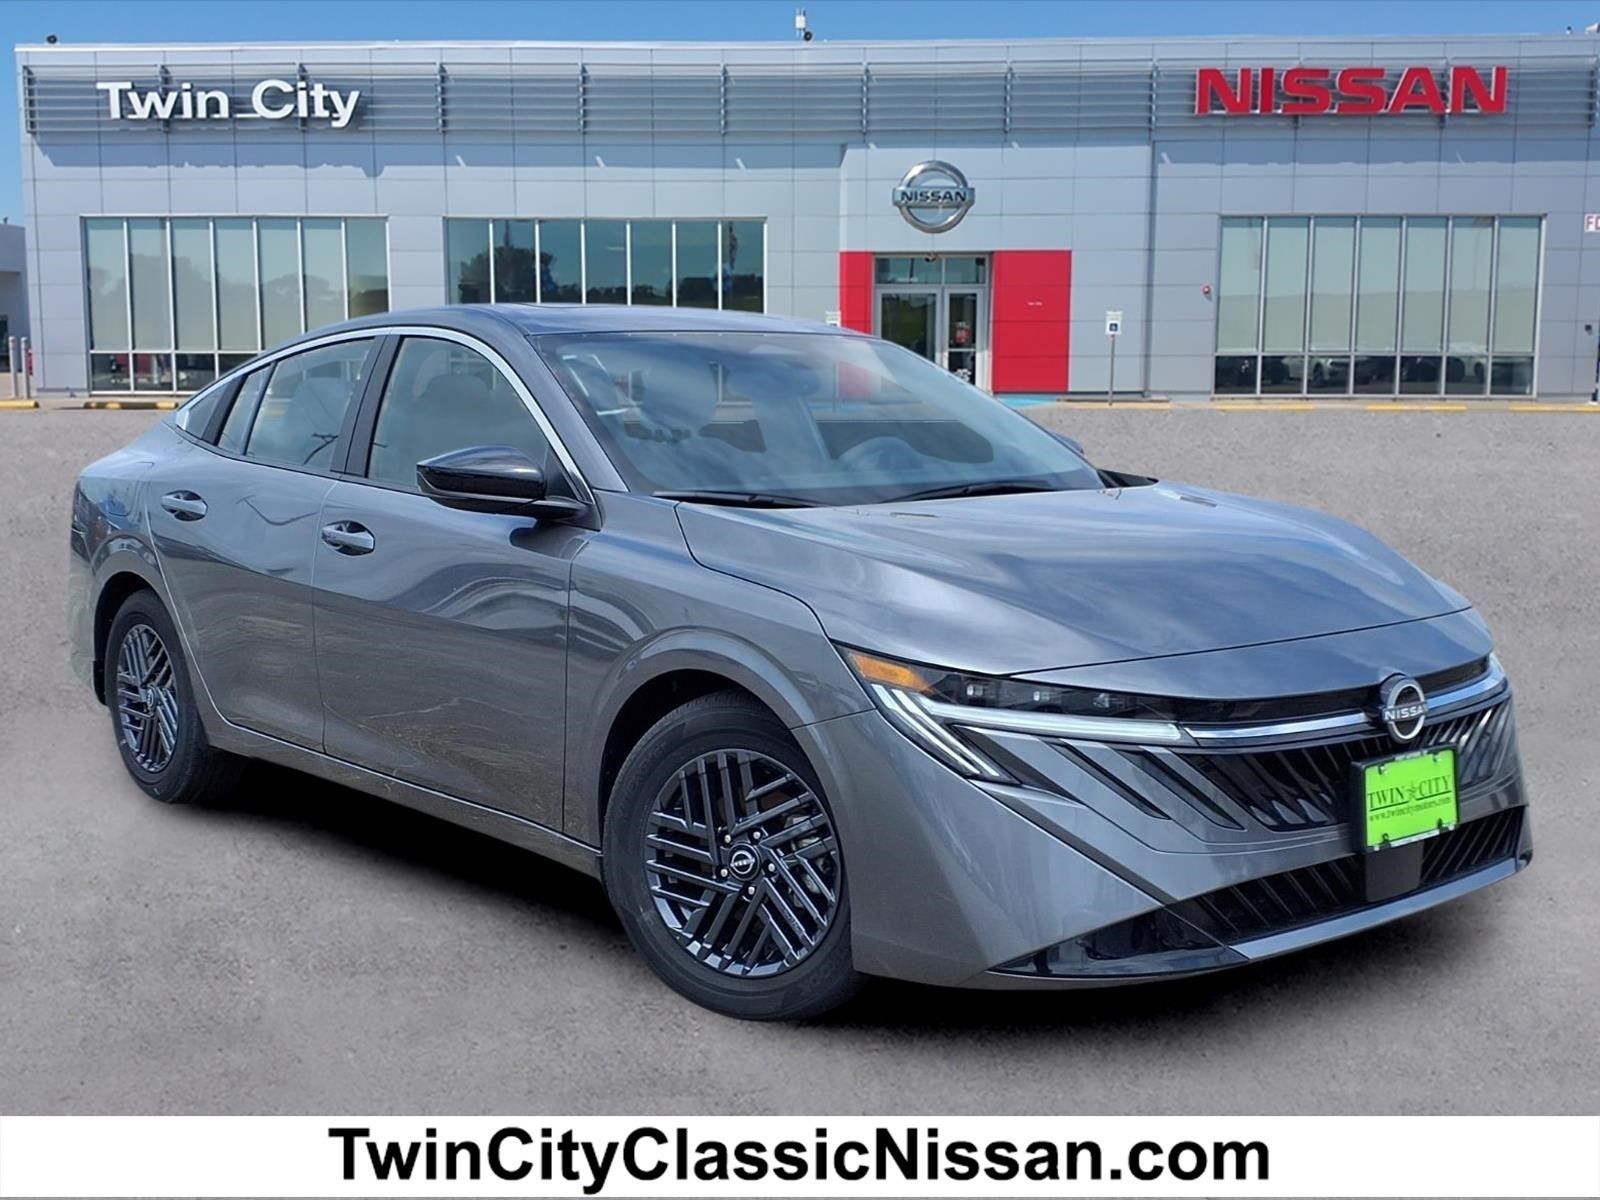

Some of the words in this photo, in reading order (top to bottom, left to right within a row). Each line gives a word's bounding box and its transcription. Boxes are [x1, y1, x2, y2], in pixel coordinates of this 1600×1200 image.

[96, 80, 229, 119] Twin
[252, 79, 360, 128] City
[1195, 66, 1508, 114] NISSAN
[901, 190, 967, 202] NISSAN
[1384, 705, 1427, 720] NISSA
[1368, 786, 1405, 808] TWIN
[1419, 775, 1451, 796] CITY
